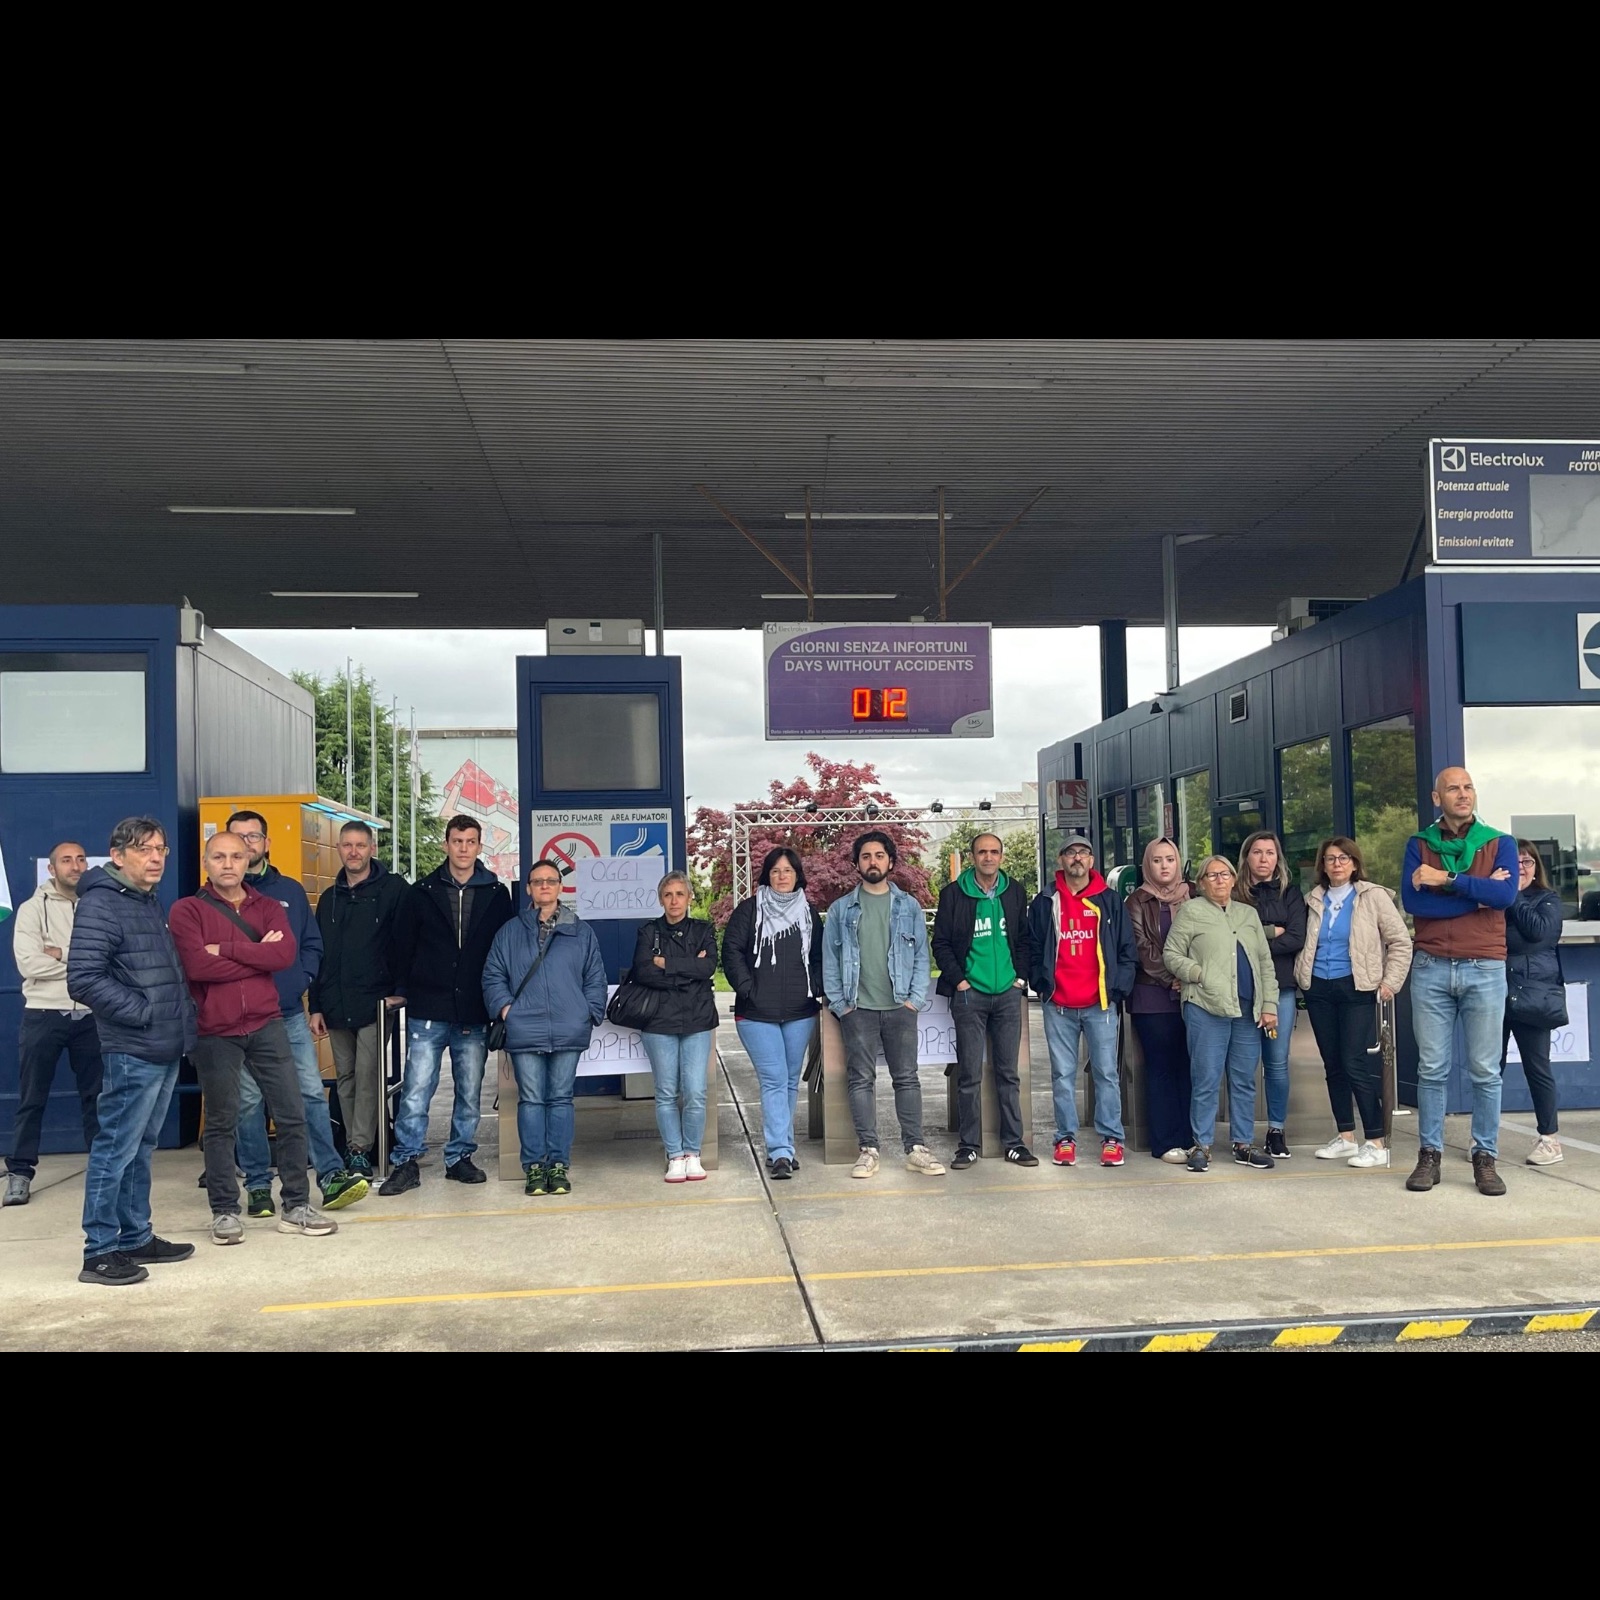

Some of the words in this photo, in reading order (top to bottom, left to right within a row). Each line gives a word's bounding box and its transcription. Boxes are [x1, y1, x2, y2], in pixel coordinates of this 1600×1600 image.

[1470, 452, 1545, 467] Electrolux
[1437, 480, 1475, 492] Potenza
[1476, 480, 1510, 492] attuale
[1438, 508, 1473, 522] Energia
[1473, 508, 1514, 521] prodotta
[1438, 536, 1481, 547] Emissioni
[1482, 536, 1514, 547] evitate
[790, 641, 840, 653] GIORNI
[843, 641, 890, 653] SENZA
[893, 641, 968, 653] INFORTUNI
[784, 660, 823, 672] DAYS
[826, 660, 890, 671] WITHOUT
[894, 659, 974, 671] ACCIDENTS
[536, 814, 569, 822] VIETATO
[571, 814, 603, 822] FUMARE
[610, 813, 630, 821] AREA
[631, 813, 668, 821] FUMATORI
[591, 861, 639, 881] OGGI
[580, 888, 658, 909] SCIOPERO
[1060, 929, 1094, 940] NAPOLI
